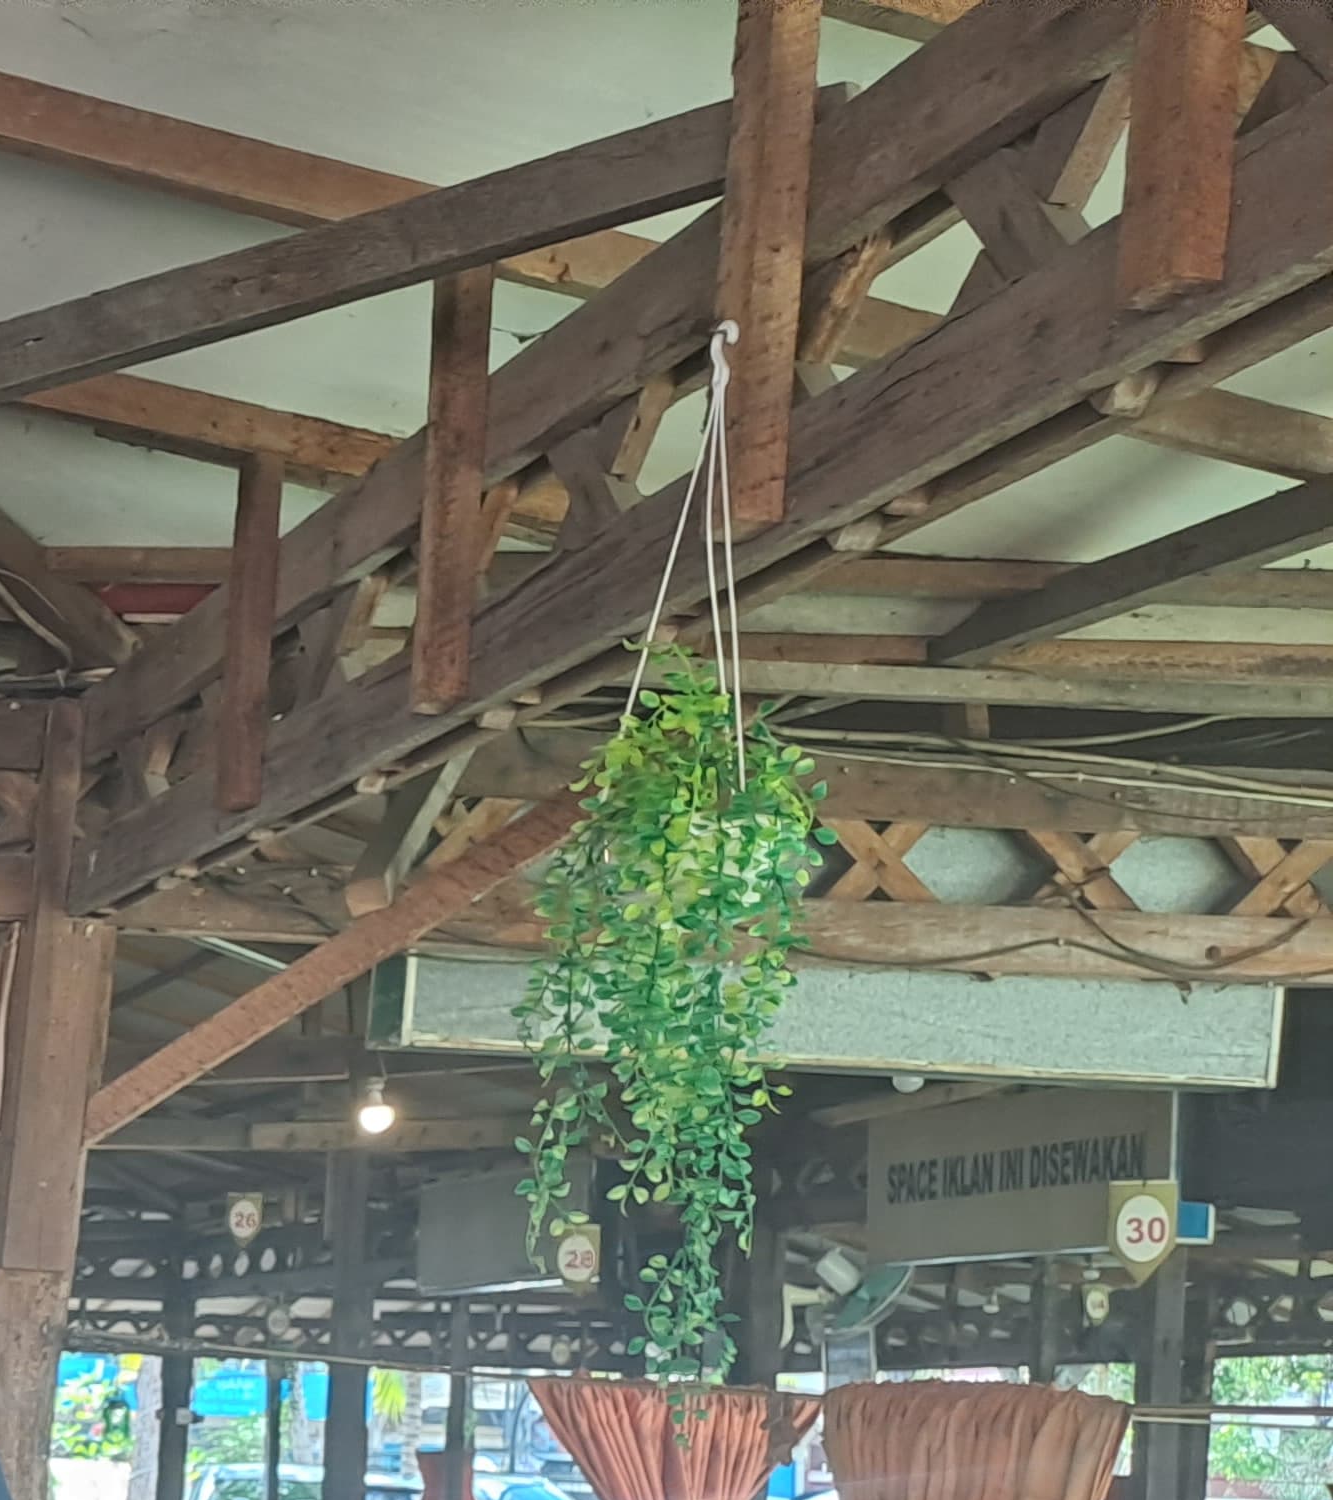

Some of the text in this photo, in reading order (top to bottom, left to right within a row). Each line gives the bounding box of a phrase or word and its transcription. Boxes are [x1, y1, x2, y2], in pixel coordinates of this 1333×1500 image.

[887, 1131, 1147, 1205] SPACE IKLAN INI DISEWAKAN
[235, 1211, 257, 1228] 26
[1125, 1216, 1166, 1244] 30
